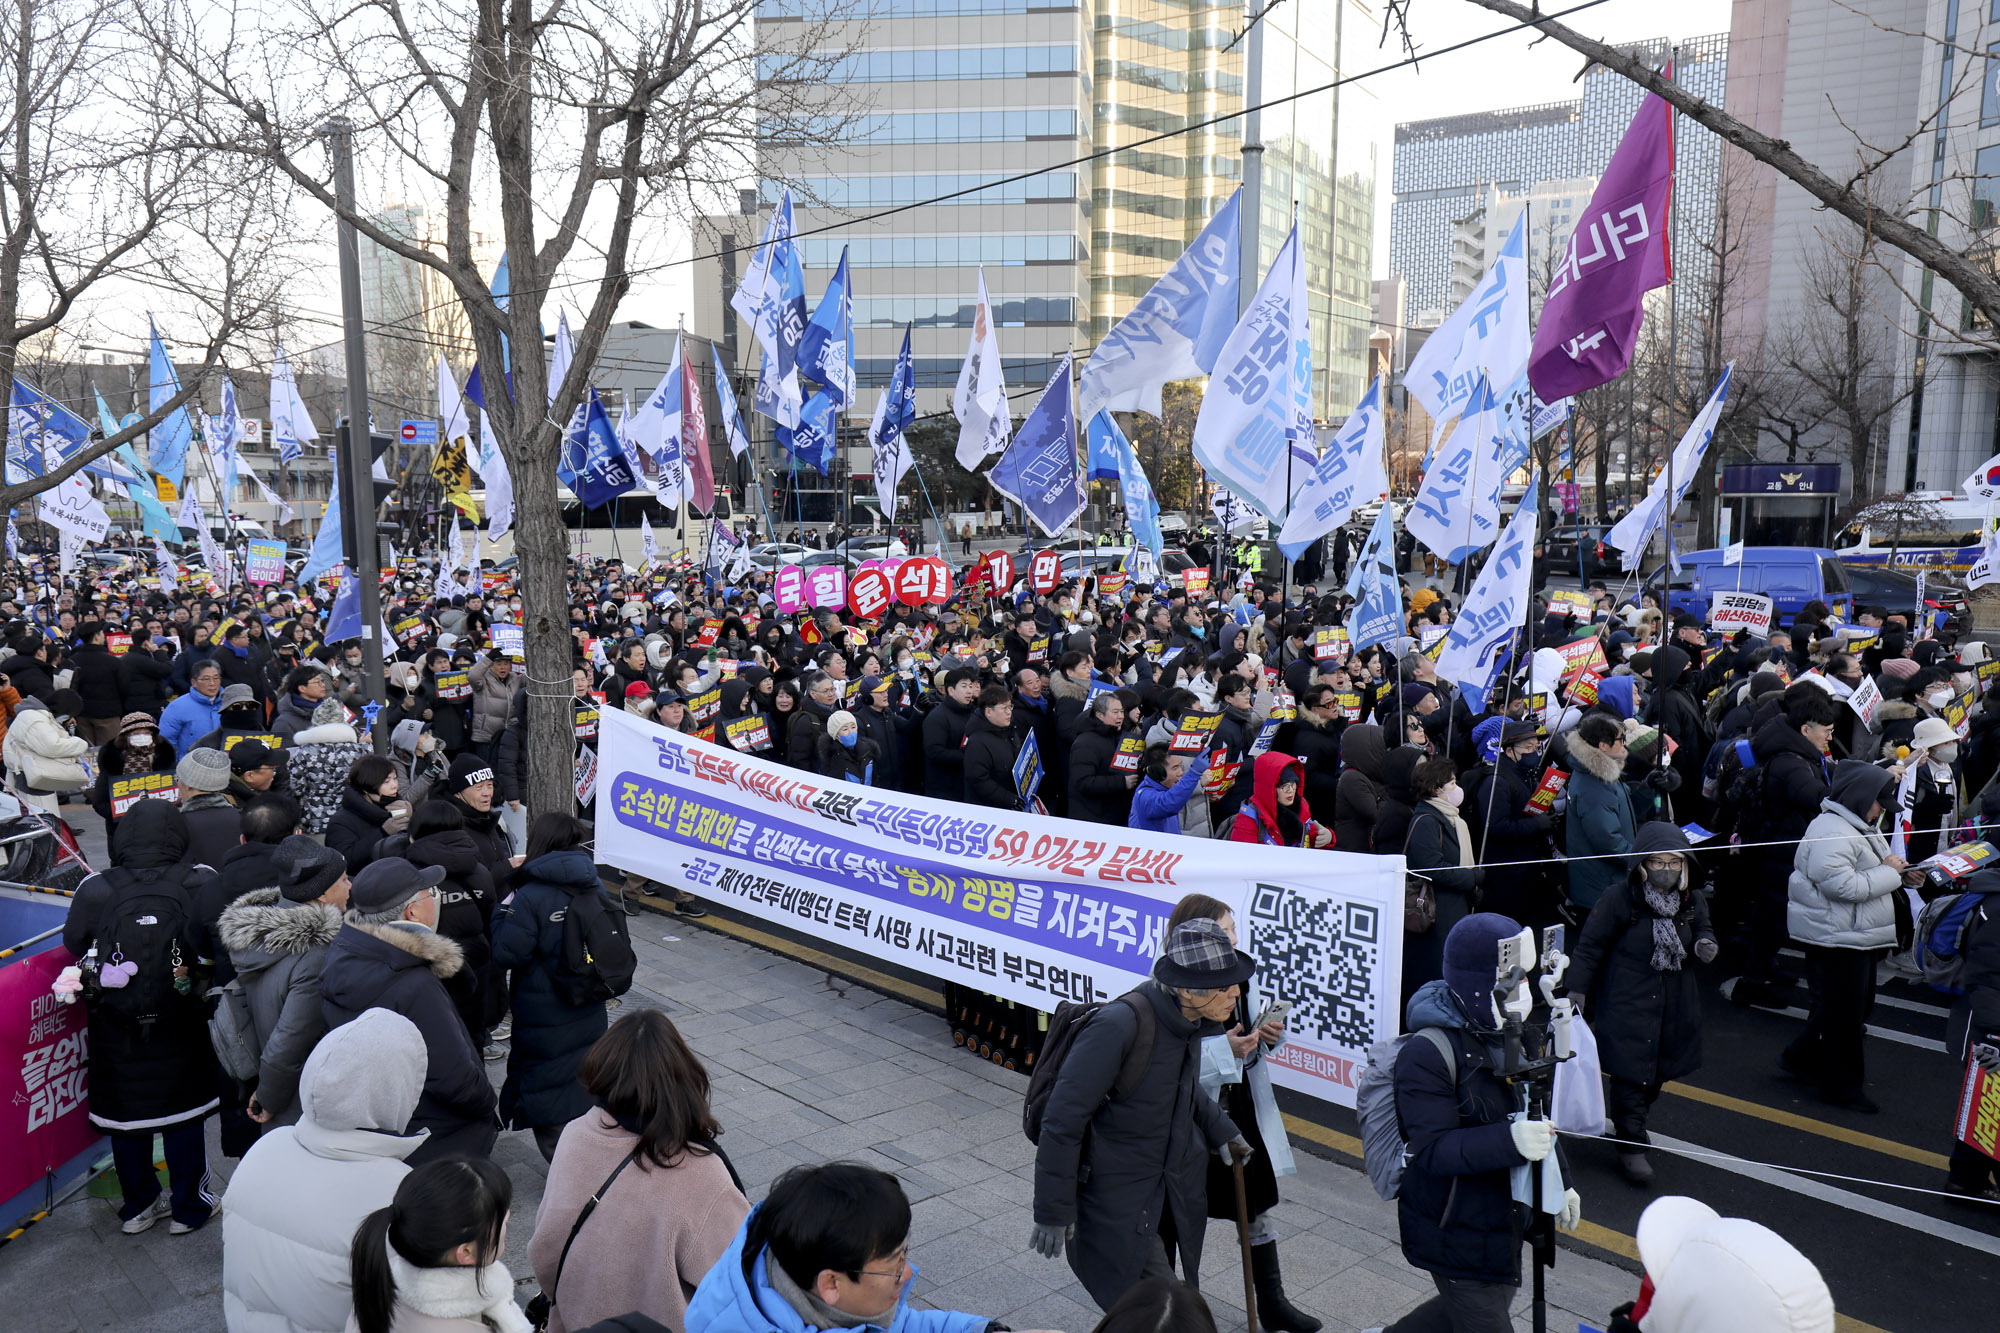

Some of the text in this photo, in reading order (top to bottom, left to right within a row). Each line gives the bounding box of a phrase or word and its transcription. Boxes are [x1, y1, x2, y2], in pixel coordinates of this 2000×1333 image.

[1766, 481, 1814, 491] 교통 안내
[252, 558, 280, 570] 해체가
[1035, 555, 1058, 582] 면
[250, 570, 281, 582] 답이다!
[901, 562, 931, 598] 석
[780, 572, 803, 606] 국
[812, 572, 845, 608] 힘
[854, 576, 886, 616] 윤
[1722, 596, 1767, 611] 국힘당을
[1714, 609, 1770, 627] 해산하라!
[1317, 628, 1348, 644] 윤석열
[438, 673, 470, 689] 윤석열
[726, 716, 764, 738] 윤석열을
[730, 727, 769, 749] 파면하라!
[1173, 733, 1212, 749] 파면
[1113, 754, 1138, 770] 파면
[112, 774, 173, 798] 윤석열을
[464, 767, 495, 786] VOGUE
[652, 736, 691, 775] 공군
[740, 767, 819, 814] 사망사고
[812, 790, 863, 827] 관련
[856, 799, 997, 859] 국민동의청원
[988, 827, 1107, 878] 59,976건
[1098, 845, 1184, 886] 달성!!
[619, 781, 1171, 960] 조속한 법제화로 짐짝보다 못한 병사 생명을 지켜주세
[715, 867, 833, 925] 제19전투비행단
[833, 901, 872, 938] 트럭
[873, 914, 912, 950] 사망
[915, 927, 997, 977] 사고관련
[1002, 951, 1108, 1004] 부모연대-
[28, 1009, 67, 1045] 혜택도
[1973, 1070, 2000, 1156] 면하라!
